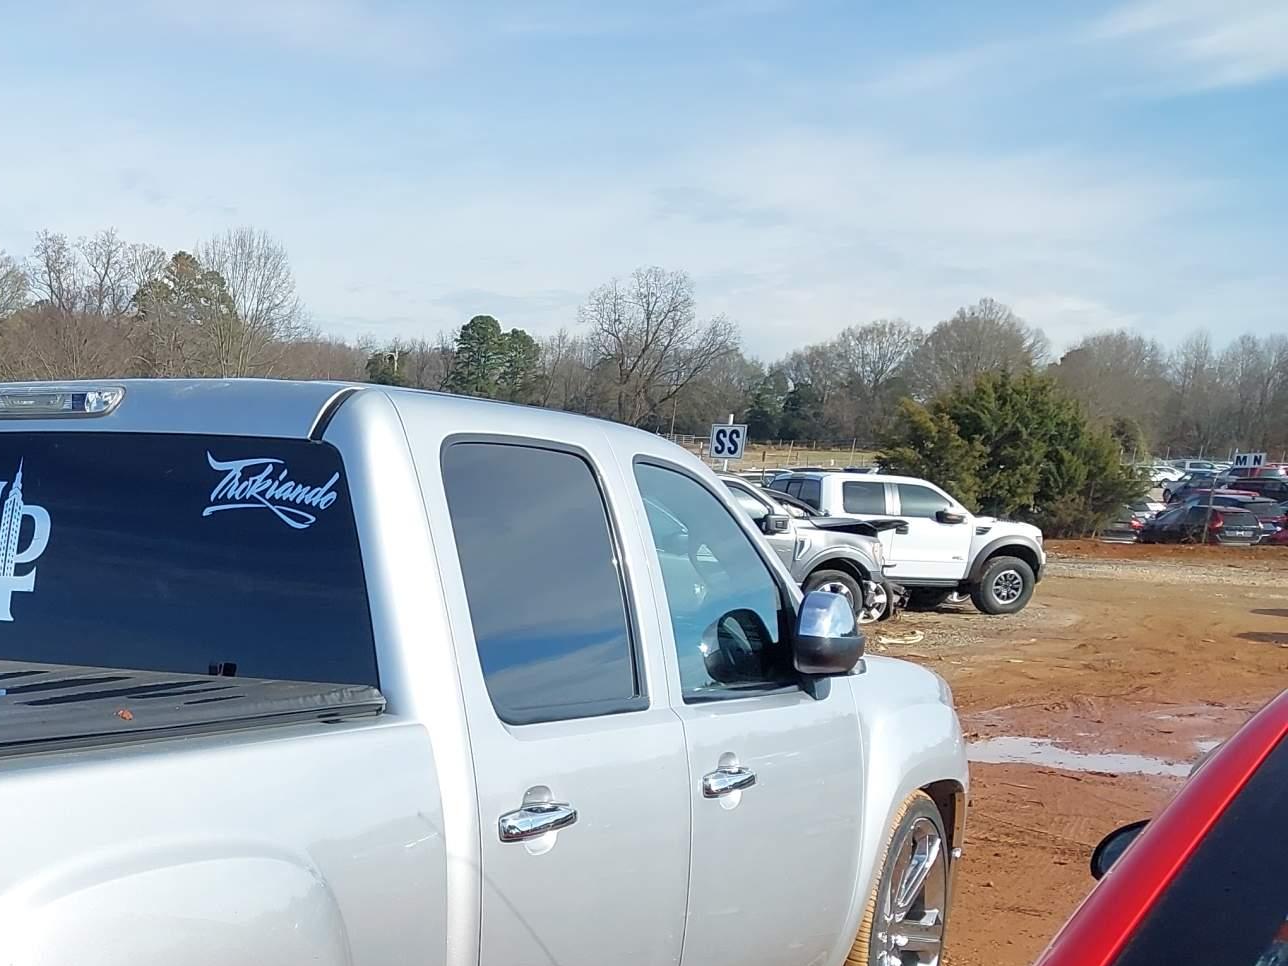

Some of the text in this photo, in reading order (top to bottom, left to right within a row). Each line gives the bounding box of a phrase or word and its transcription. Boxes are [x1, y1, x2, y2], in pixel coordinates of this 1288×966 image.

[714, 428, 741, 456] SS
[1235, 454, 1263, 466] M N
[202, 449, 341, 530] Trokiando
